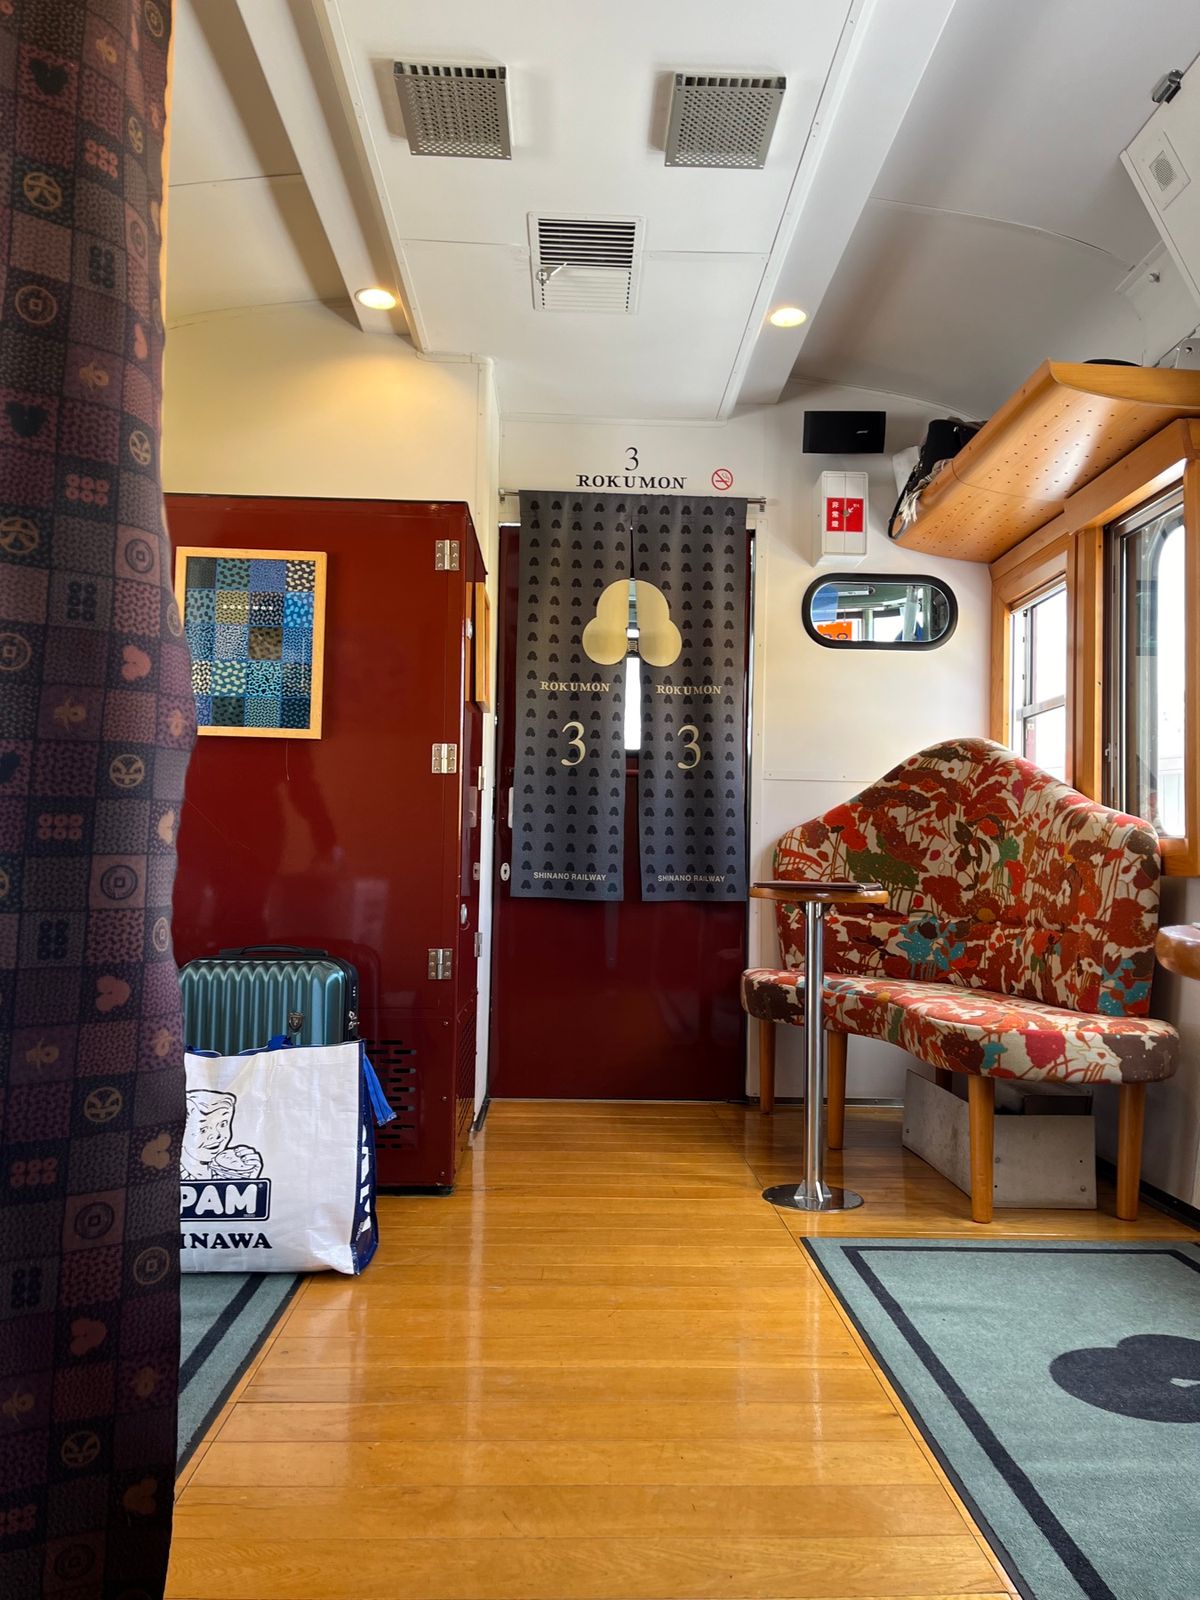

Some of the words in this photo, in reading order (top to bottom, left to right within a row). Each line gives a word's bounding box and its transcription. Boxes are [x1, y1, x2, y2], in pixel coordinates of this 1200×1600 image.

[625, 447, 639, 471] 3
[576, 474, 687, 489] ROKUMON
[540, 681, 610, 692] ROKUMON
[656, 684, 722, 695] ROKUMON
[561, 721, 586, 766] 3
[677, 724, 701, 770] 3
[533, 871, 569, 880] SHINANO
[571, 873, 607, 881] RAILWAY
[692, 875, 725, 883] RAILWAY
